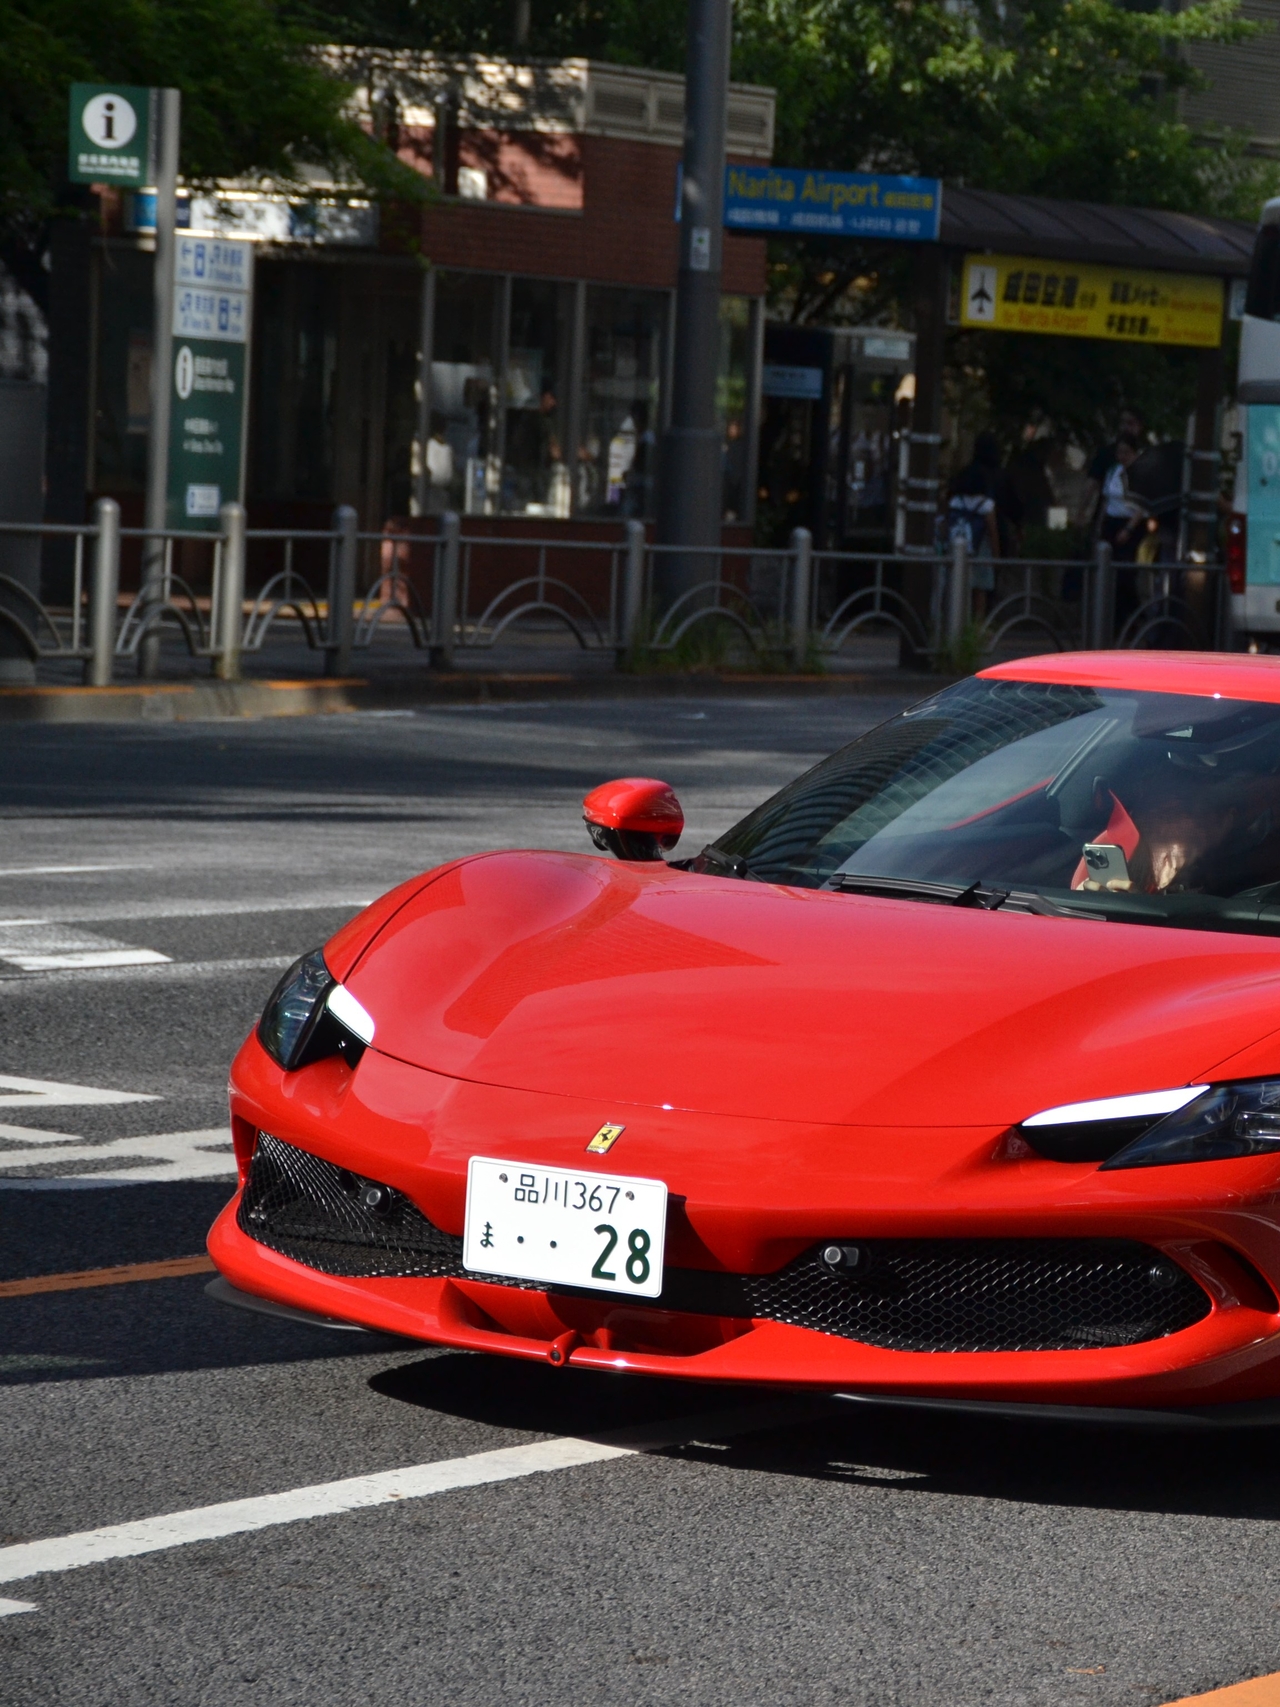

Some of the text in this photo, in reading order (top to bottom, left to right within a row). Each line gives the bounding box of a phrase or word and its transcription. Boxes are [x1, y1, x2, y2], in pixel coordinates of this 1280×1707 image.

[727, 170, 796, 201] Narita
[801, 173, 880, 213] Airport
[480, 1221, 495, 1248] ま
